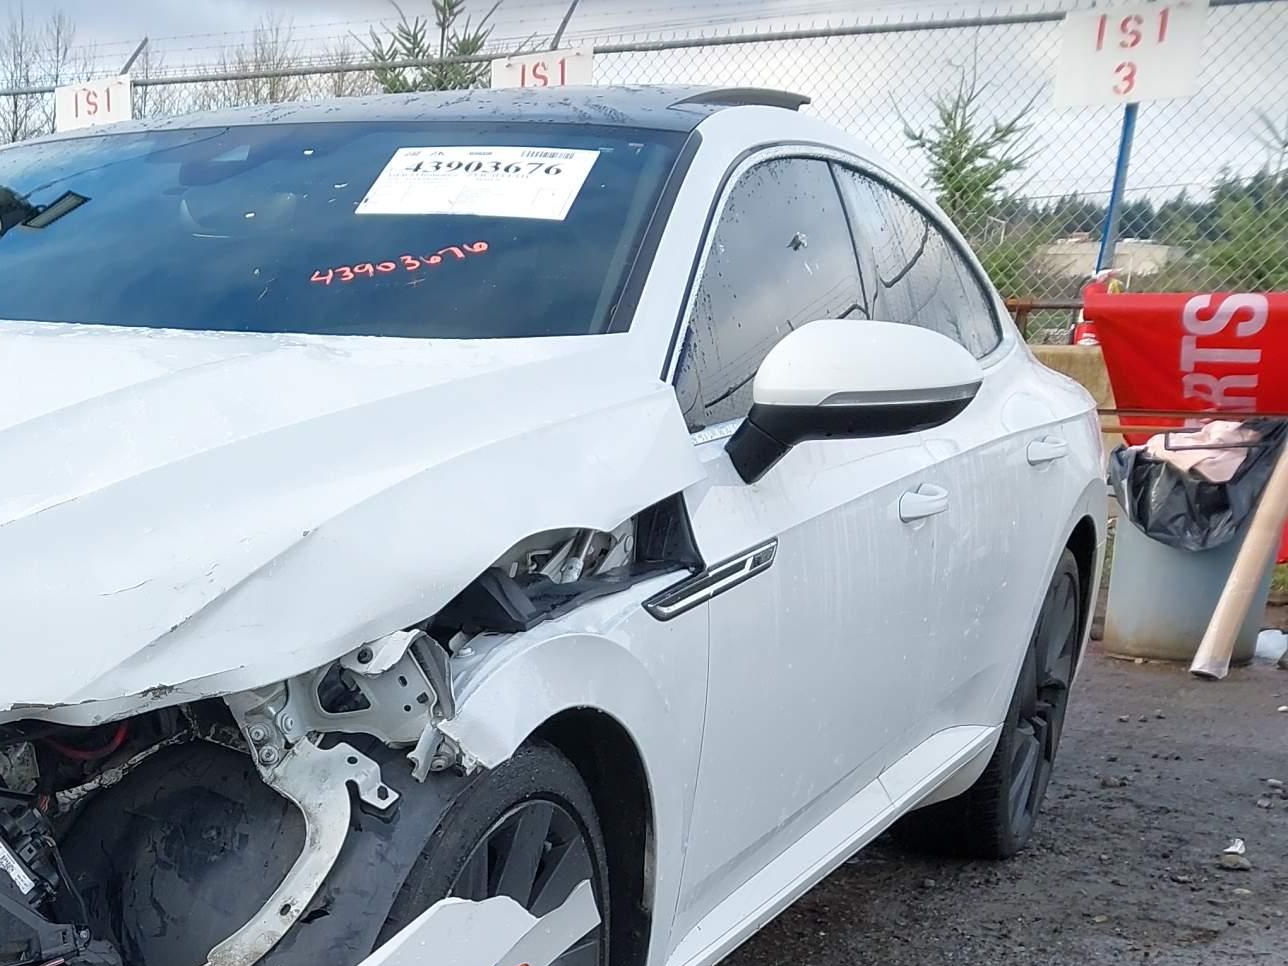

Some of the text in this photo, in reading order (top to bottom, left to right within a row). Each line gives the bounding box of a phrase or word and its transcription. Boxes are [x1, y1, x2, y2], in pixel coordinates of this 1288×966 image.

[1112, 61, 1137, 95] 3
[404, 161, 563, 176] 43903676
[310, 241, 488, 285] 43903676
[1180, 293, 1269, 415] RTS
